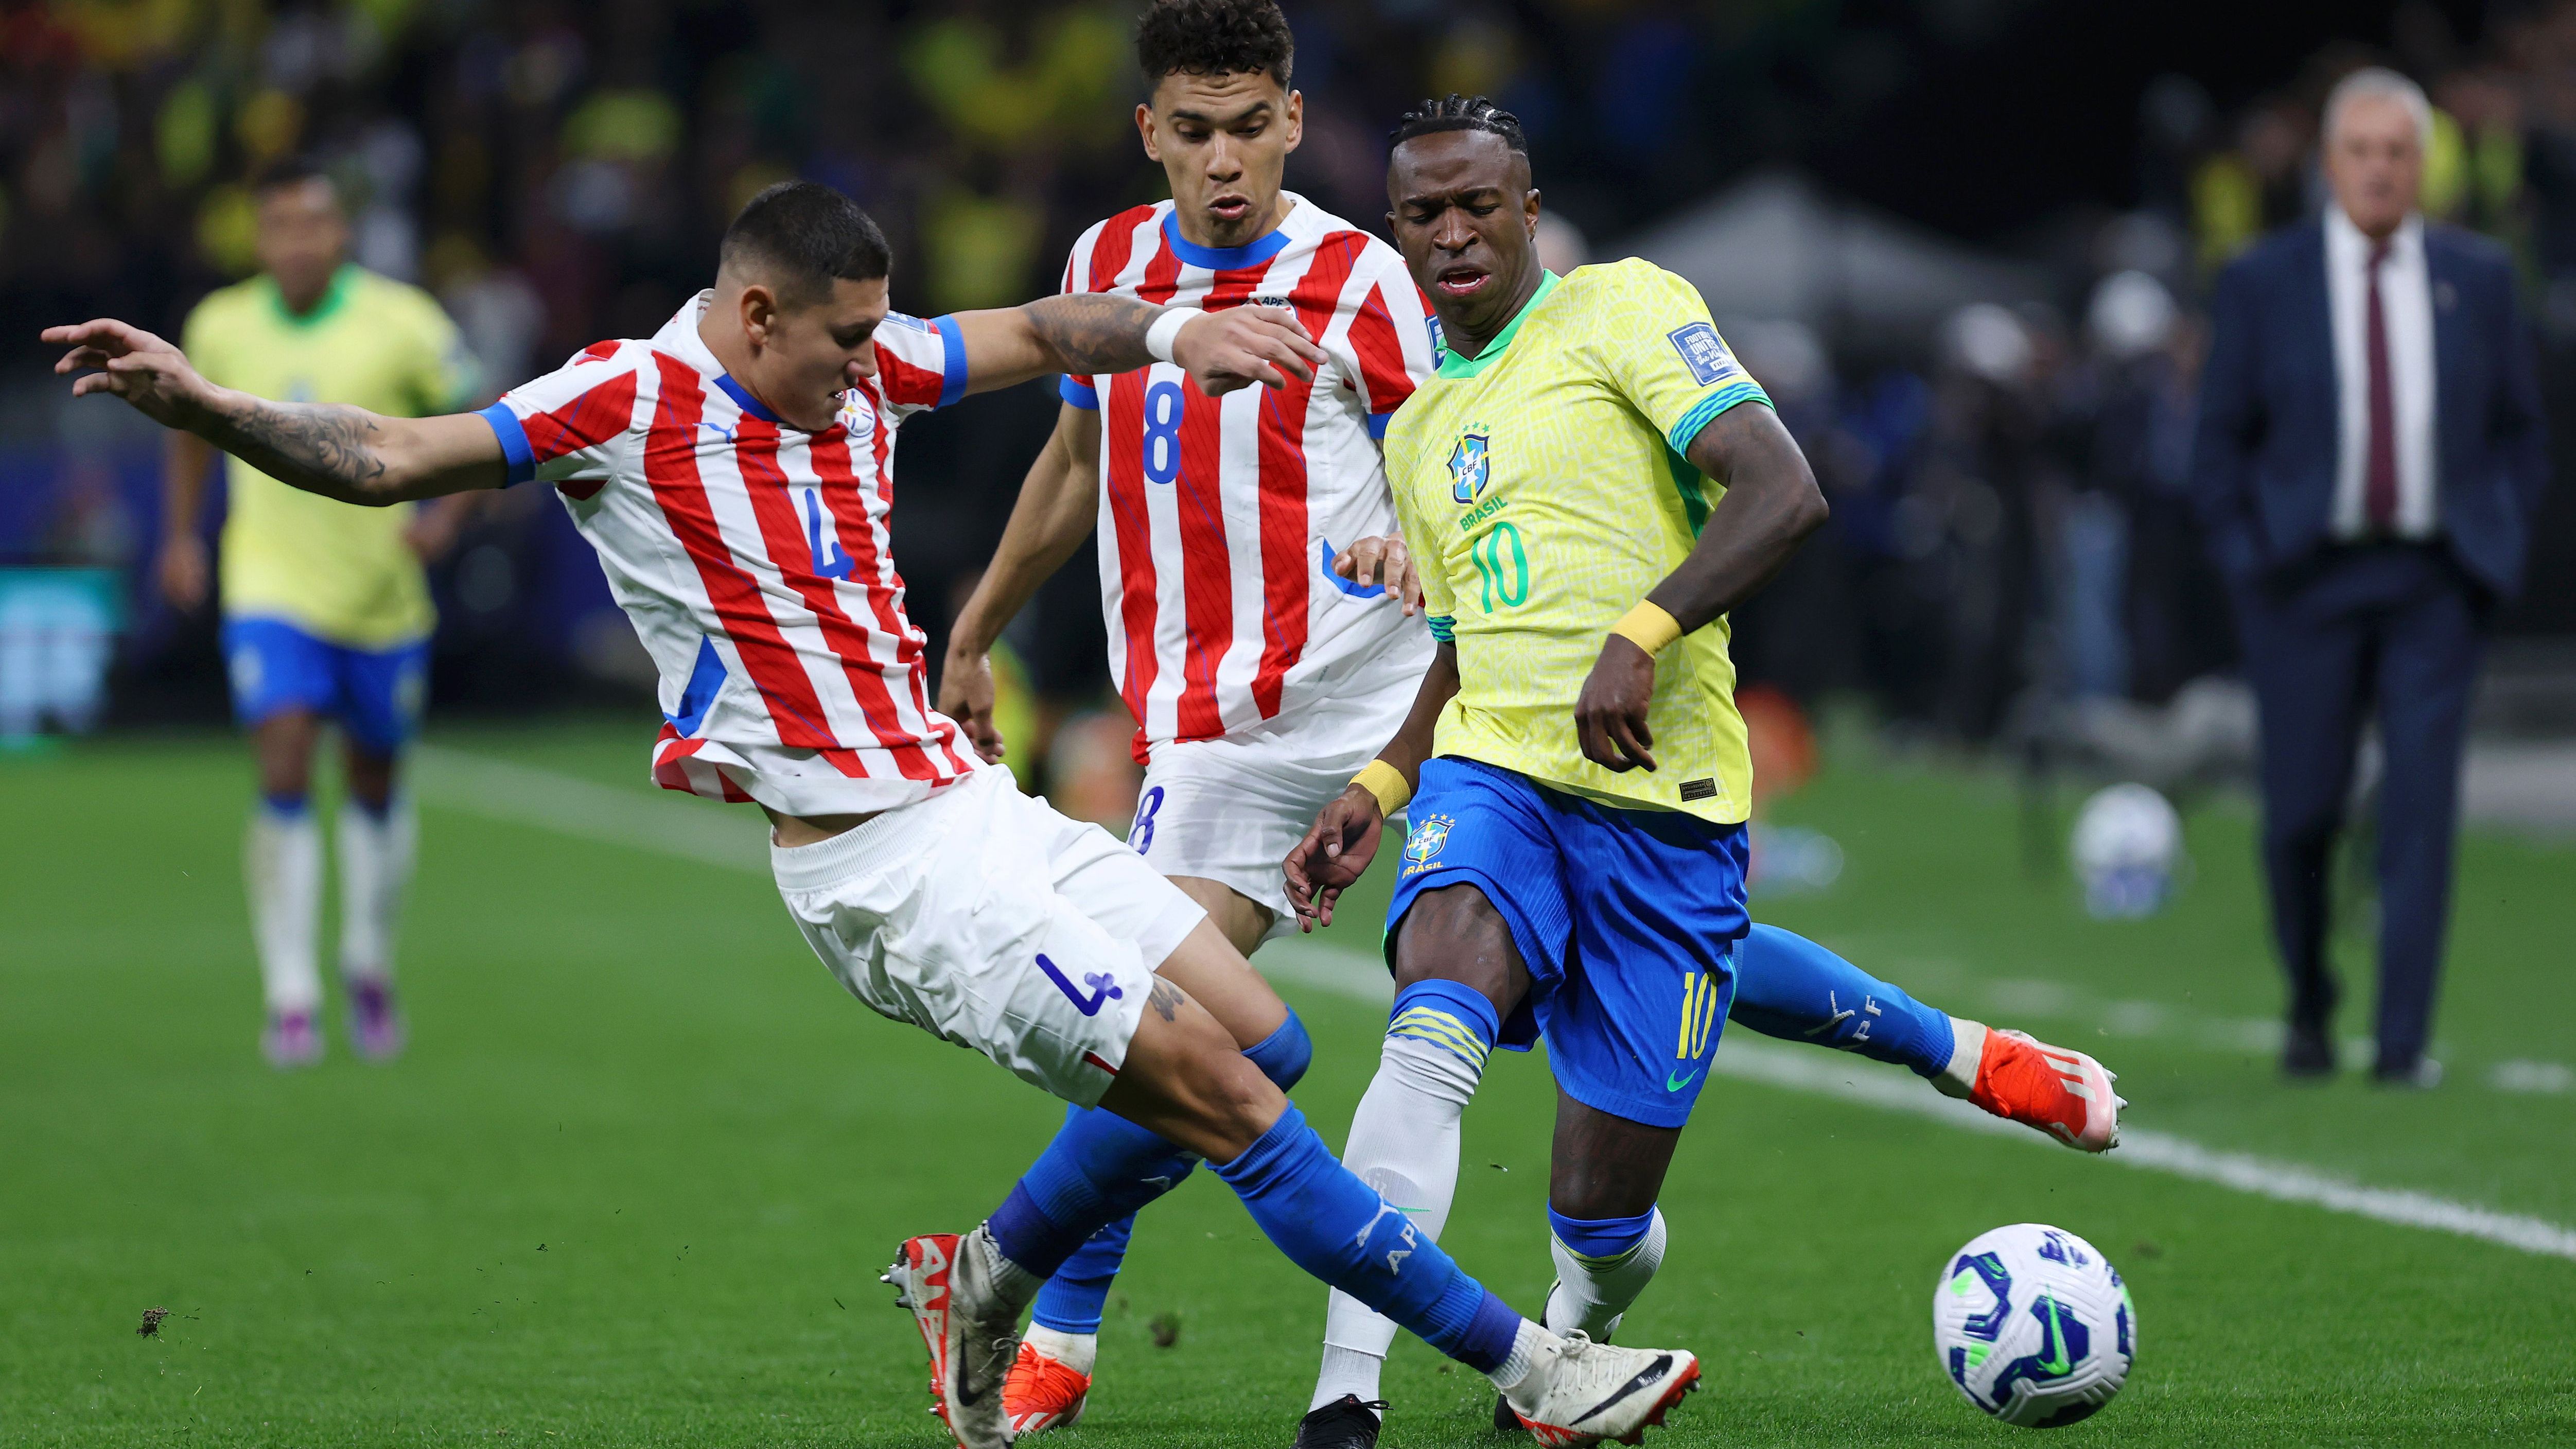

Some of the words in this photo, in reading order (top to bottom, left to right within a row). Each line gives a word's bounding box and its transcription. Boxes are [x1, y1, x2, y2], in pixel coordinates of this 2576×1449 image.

[1262, 296, 1284, 306] APF
[1695, 354, 1709, 365] the
[1143, 381, 1184, 484] 8
[1462, 460, 1477, 476] CBF
[804, 487, 855, 581] 4
[1460, 496, 1508, 532] BRASIL
[1471, 521, 1528, 614] 10
[1129, 786, 1164, 855] 8
[1418, 836, 1434, 844] CBF
[1035, 953, 1123, 1017] 4
[1676, 971, 1717, 1060] 10
[1387, 1219, 1421, 1276] AP
